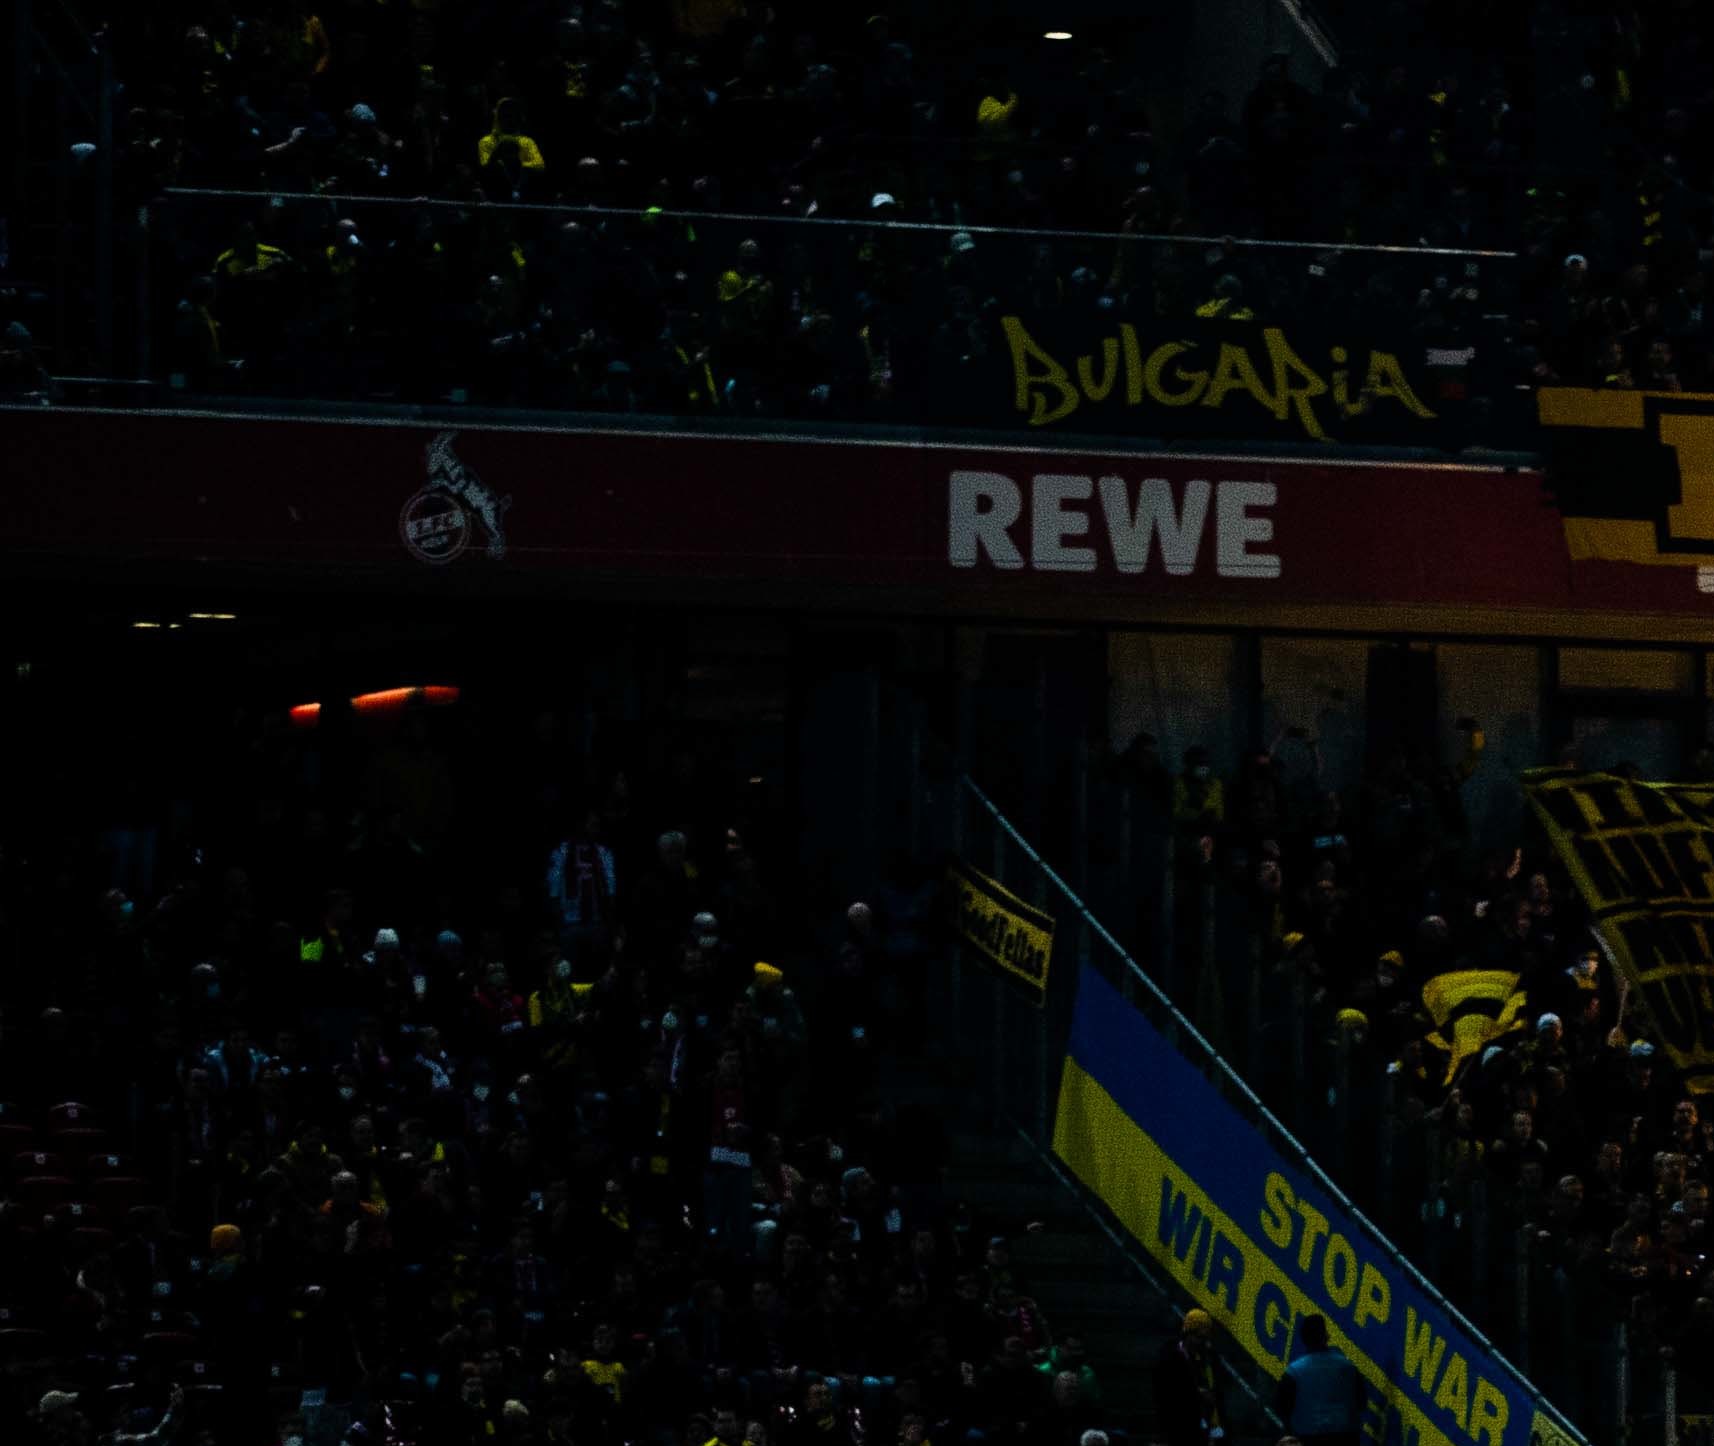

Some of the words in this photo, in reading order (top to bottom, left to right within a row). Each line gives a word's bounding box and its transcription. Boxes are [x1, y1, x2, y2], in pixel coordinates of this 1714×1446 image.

[948, 471, 1283, 578] REWE
[1157, 1175, 1246, 1314] WIR
[1260, 1171, 1392, 1328] STOP
